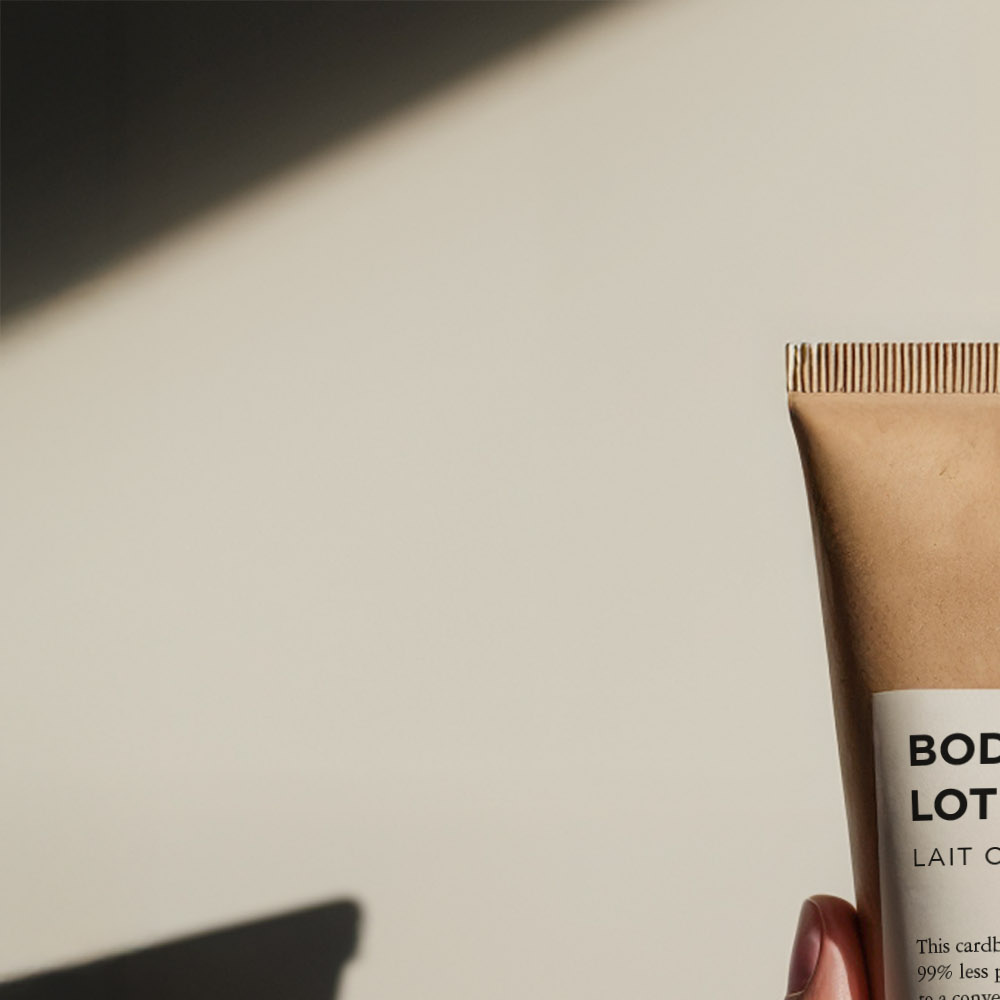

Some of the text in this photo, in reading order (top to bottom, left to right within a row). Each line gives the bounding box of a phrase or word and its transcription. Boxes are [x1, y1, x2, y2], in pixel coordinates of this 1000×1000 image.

[913, 847, 973, 867] LAIT
[916, 937, 950, 954] This
[917, 964, 953, 982] 99%
[959, 963, 989, 979] less
